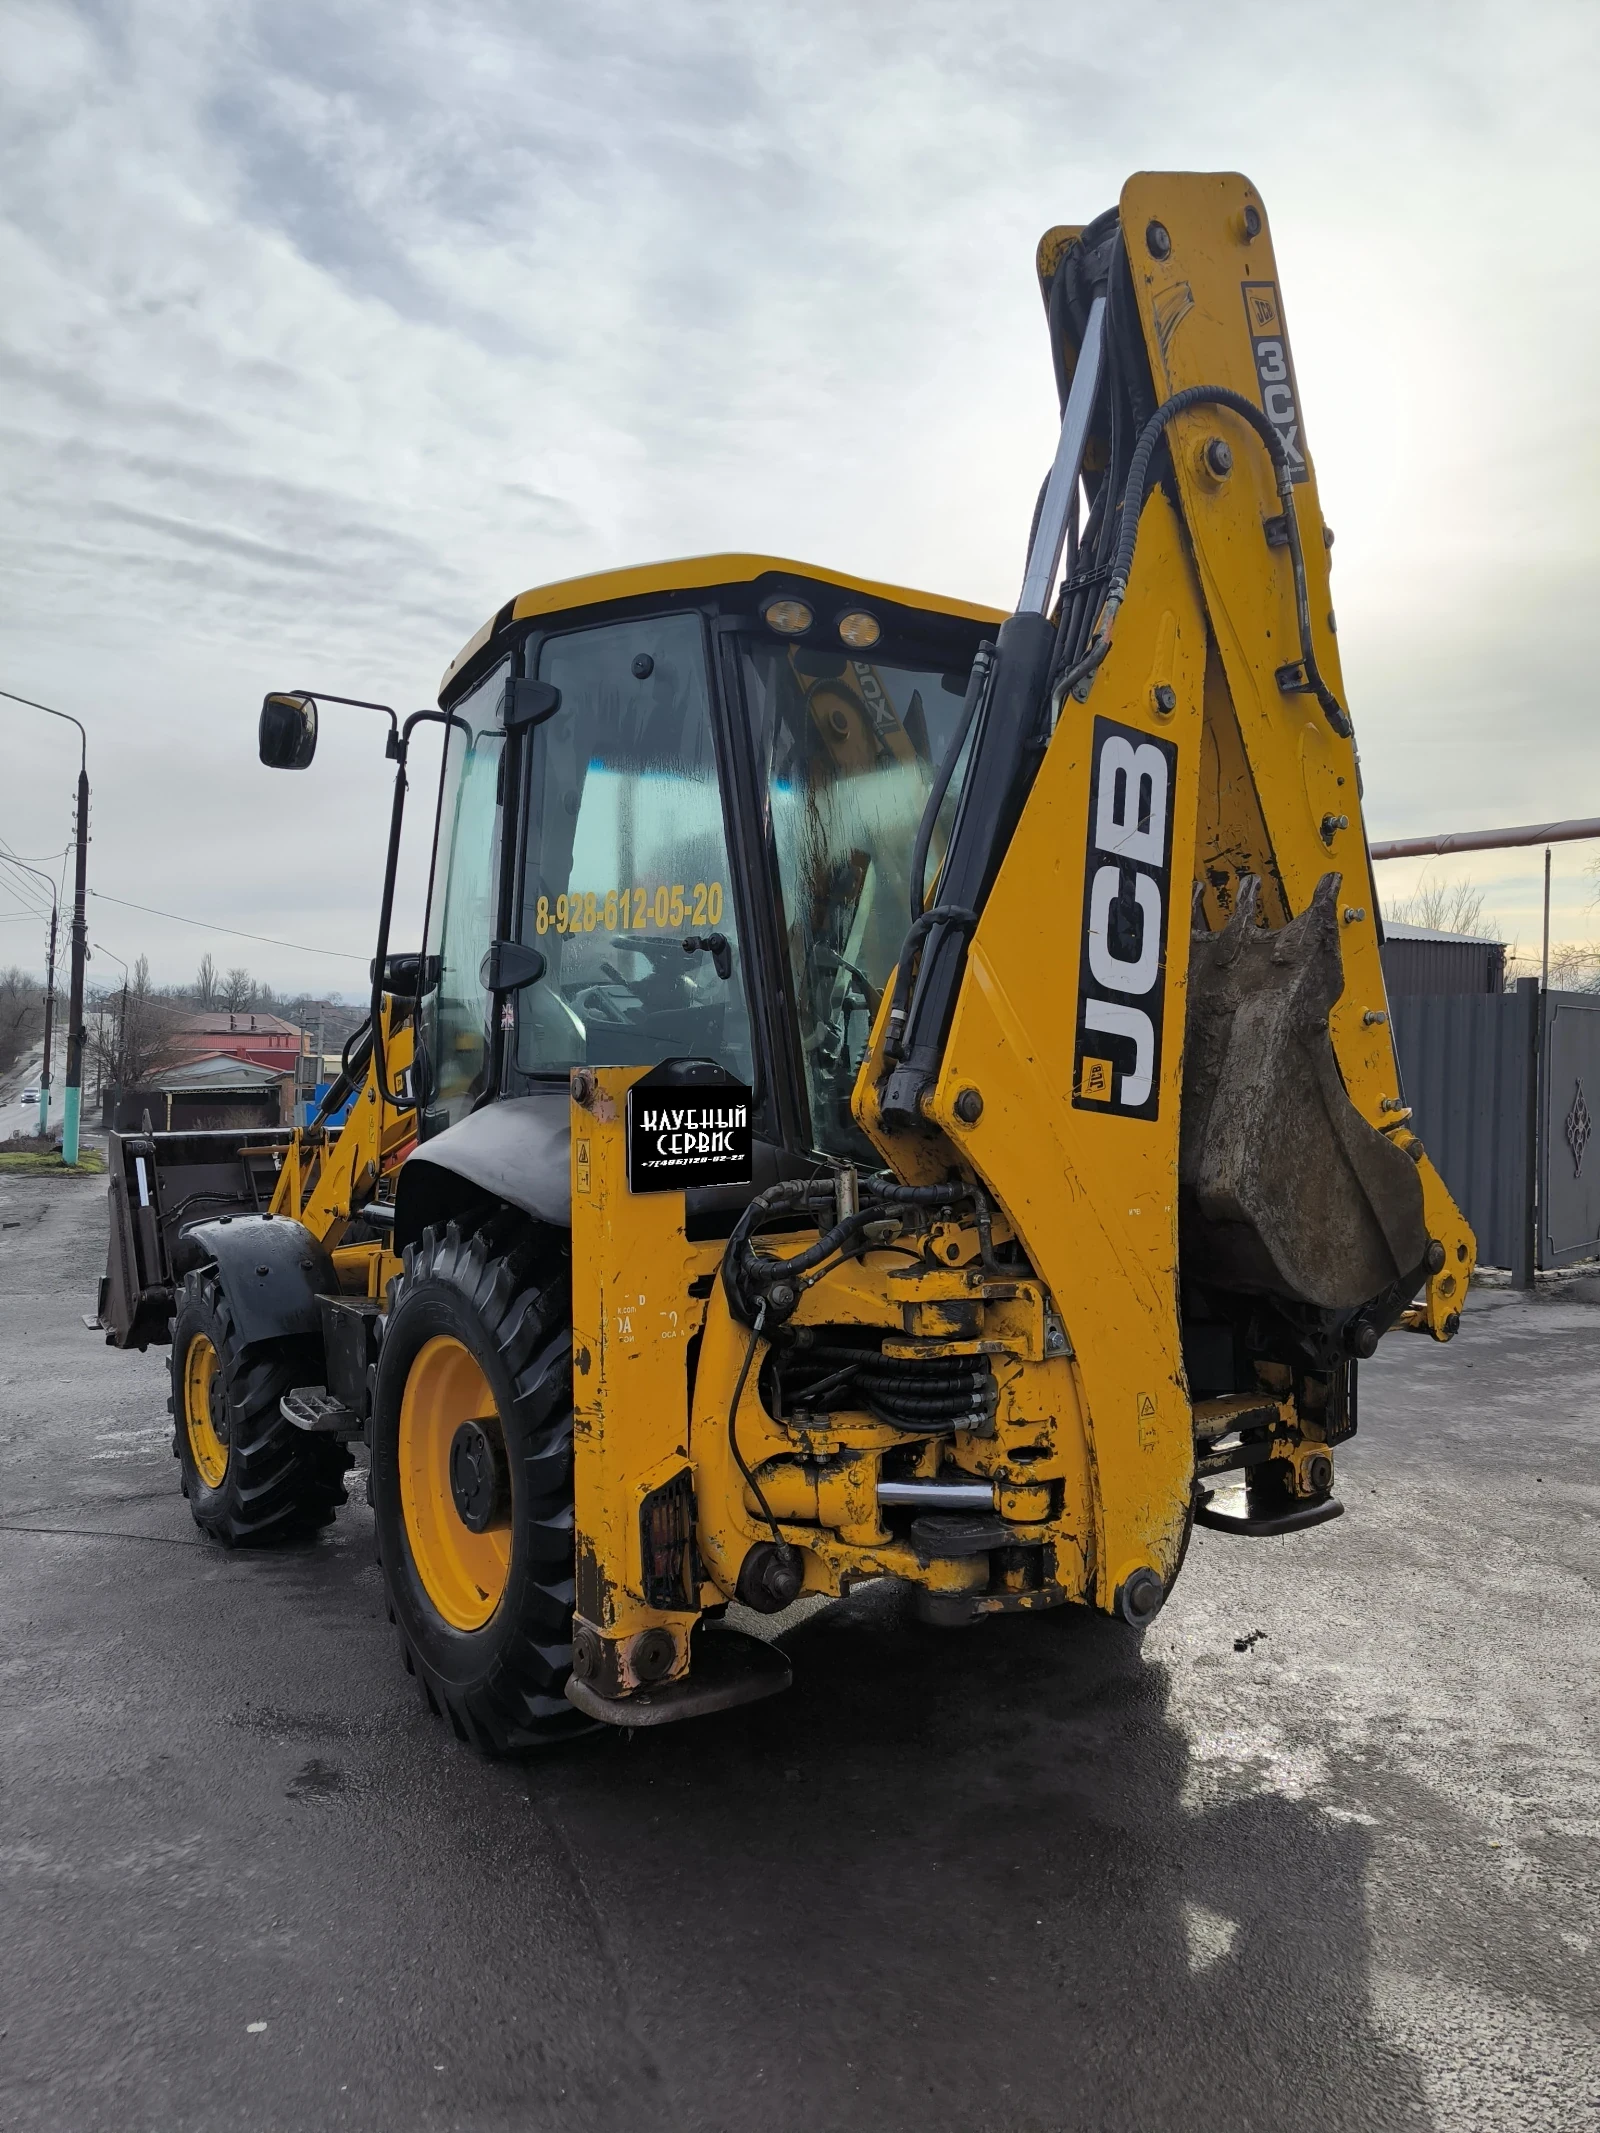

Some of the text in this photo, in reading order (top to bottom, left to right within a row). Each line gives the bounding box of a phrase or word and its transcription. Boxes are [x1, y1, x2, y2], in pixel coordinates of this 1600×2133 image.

[1254, 300, 1273, 324] JCB
[1257, 341, 1305, 463] 3CX
[536, 881, 723, 935] 8-928-612-05-20
[1085, 735, 1168, 1106] JCB
[1090, 1065, 1105, 1089] JCB
